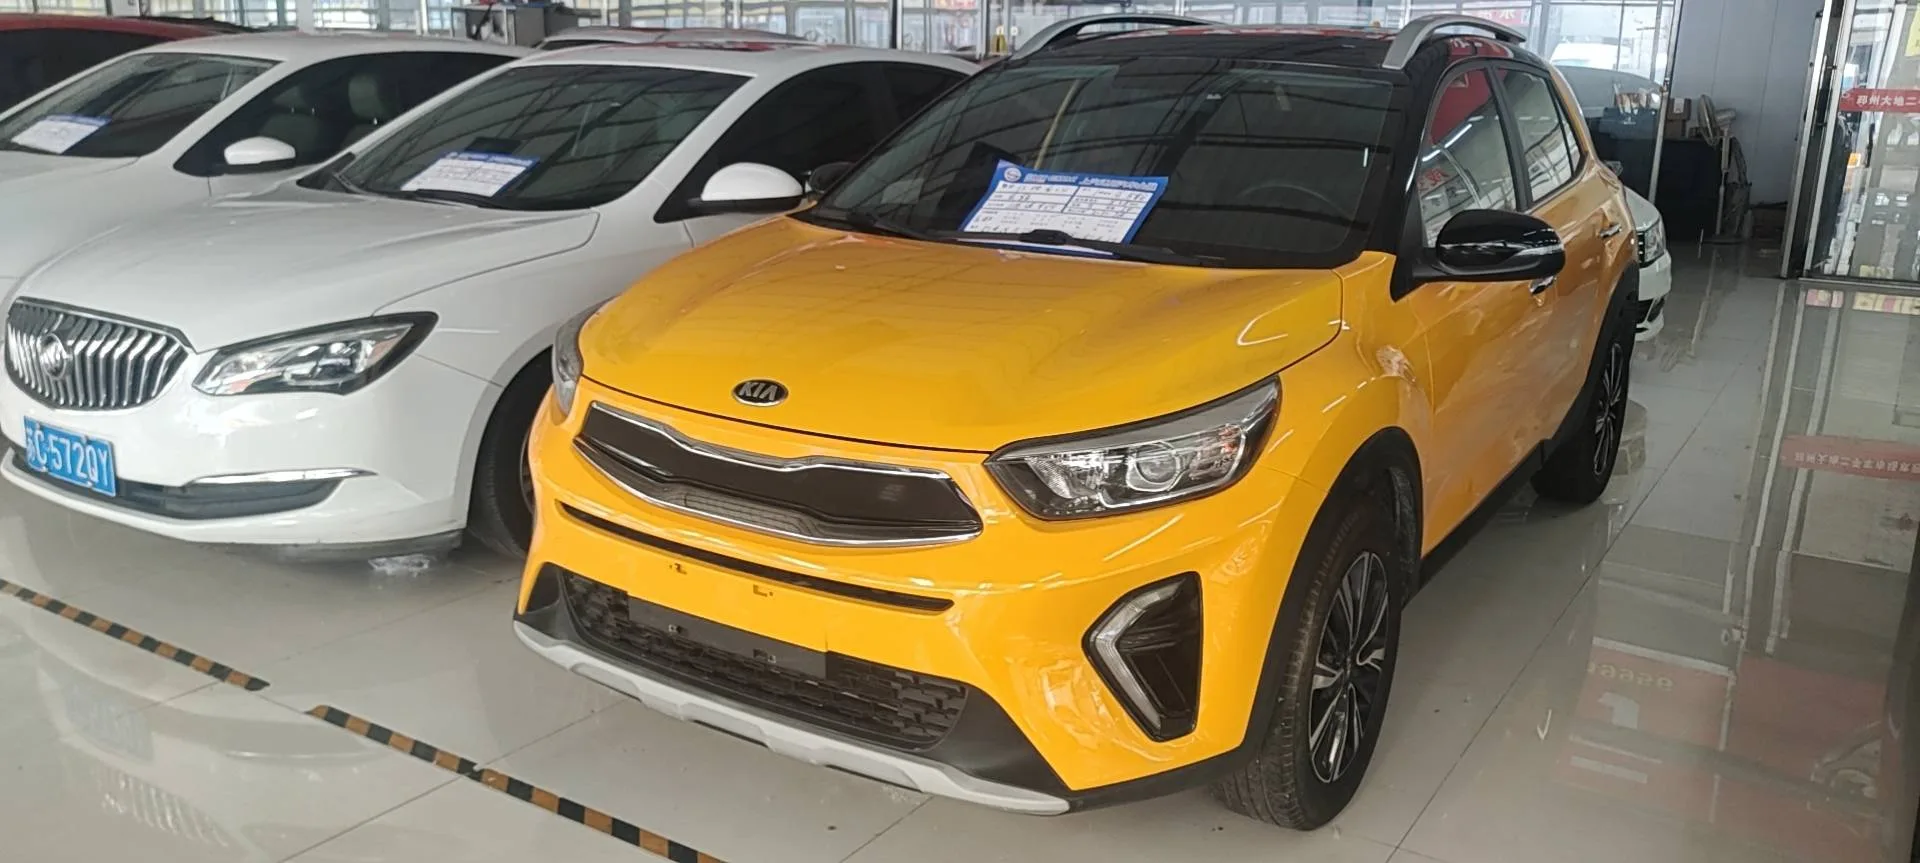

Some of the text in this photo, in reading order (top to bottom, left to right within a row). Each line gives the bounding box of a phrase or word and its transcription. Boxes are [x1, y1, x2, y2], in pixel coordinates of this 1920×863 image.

[1856, 95, 1920, 107] 邳州大地二
[738, 381, 779, 401] KIA
